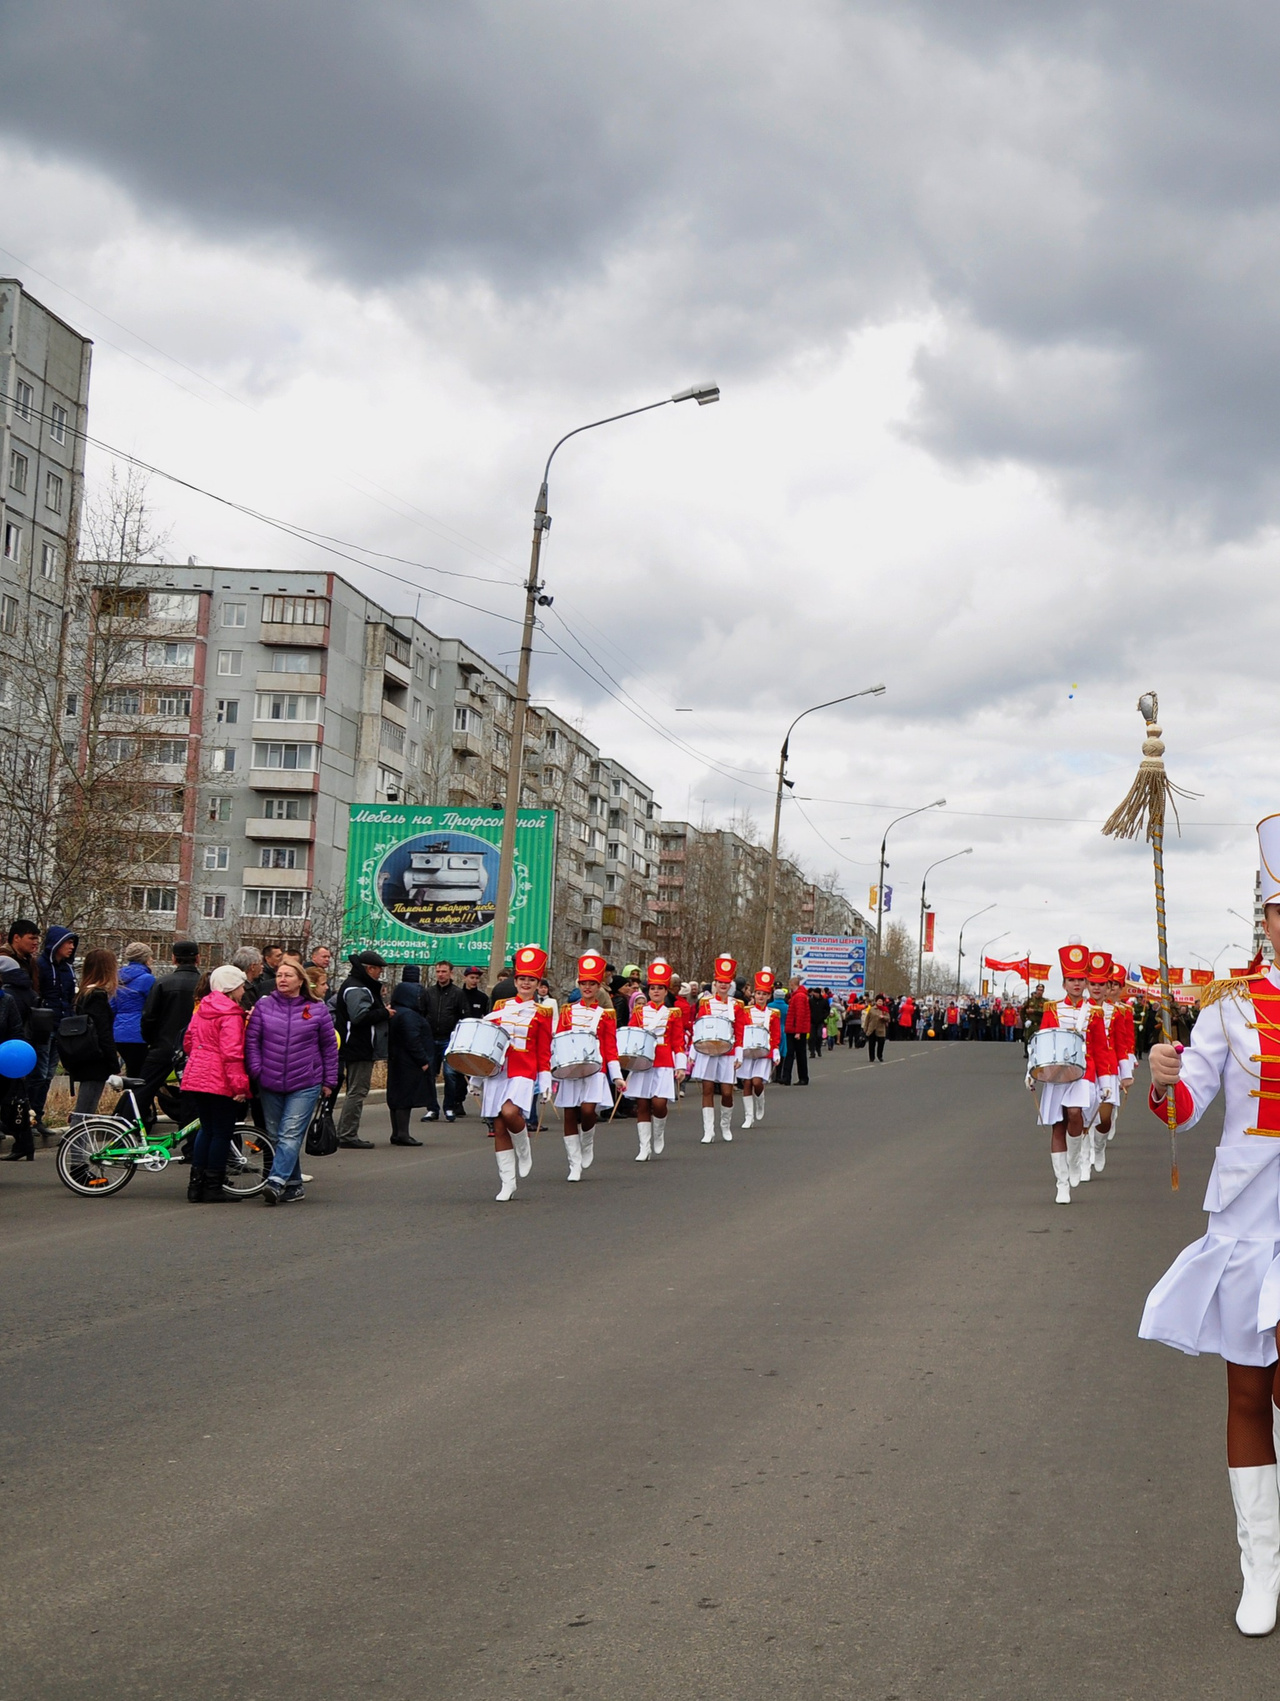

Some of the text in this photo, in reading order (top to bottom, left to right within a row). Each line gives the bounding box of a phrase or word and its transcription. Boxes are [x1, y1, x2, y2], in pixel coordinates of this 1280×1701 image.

[350, 809, 548, 830] Мебель на Профсоной
[391, 903, 434, 913] Поменяй
[435, 903, 470, 914] старую
[359, 937, 430, 949] Профсоюзная,
[431, 940, 438, 949] 2
